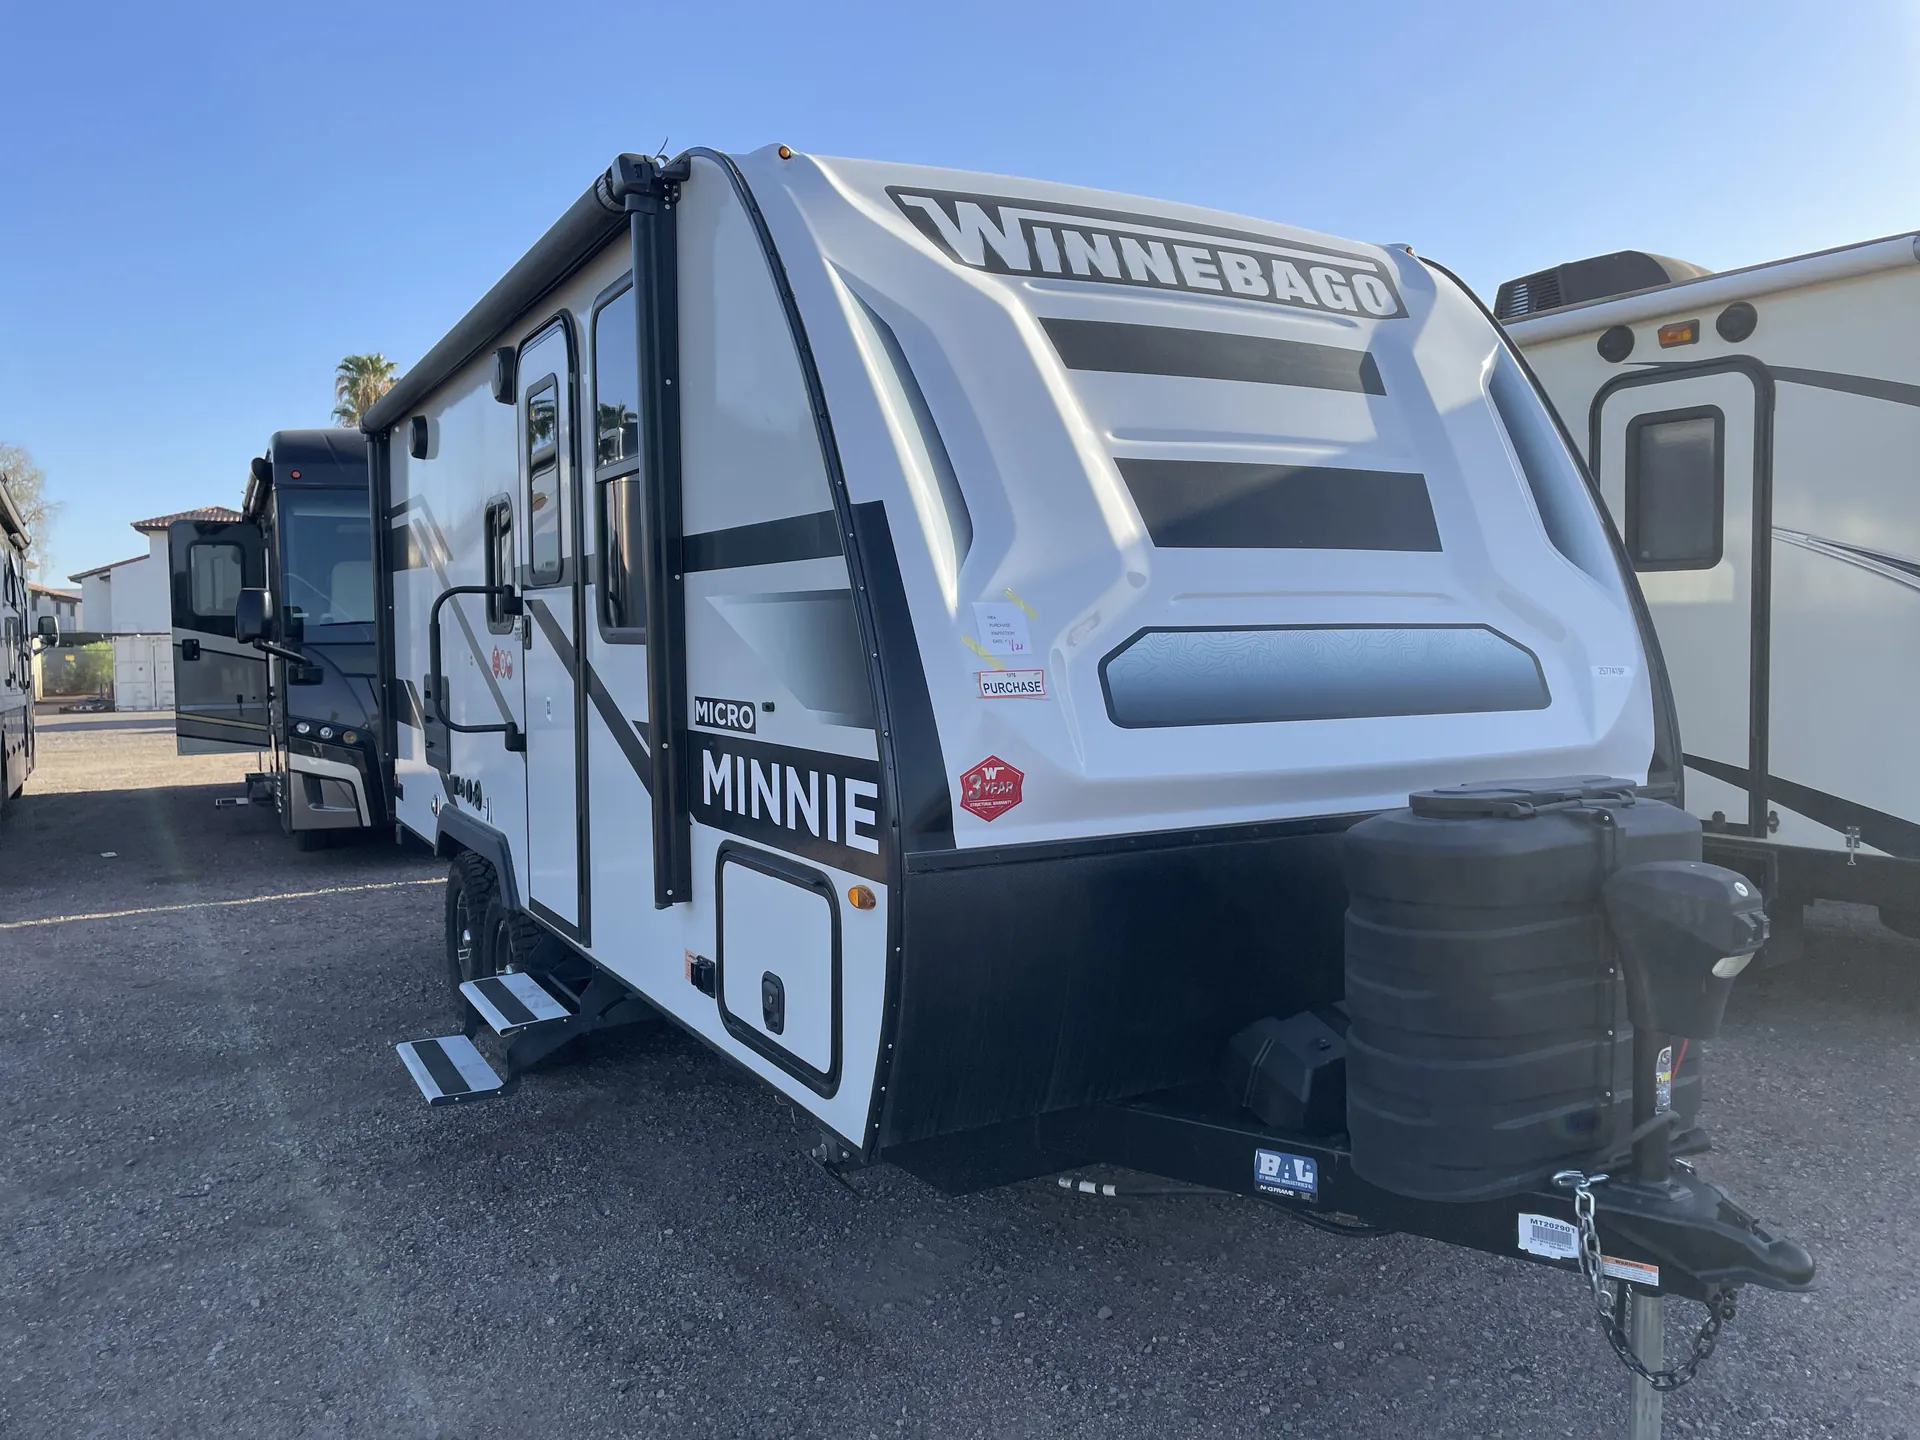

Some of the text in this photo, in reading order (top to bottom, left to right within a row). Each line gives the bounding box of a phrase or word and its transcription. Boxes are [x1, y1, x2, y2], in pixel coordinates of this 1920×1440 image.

[898, 194, 1399, 316] WINNEBAGO
[983, 681, 1042, 694] PURCHASE
[695, 699, 754, 730] MICRO
[968, 774, 1014, 799] 3 YEAR
[702, 749, 879, 855] MINNIE
[1273, 1187, 1295, 1196] FRAME
[1530, 1218, 1576, 1234] MT202901
[1615, 1260, 1645, 1269] WARNING
